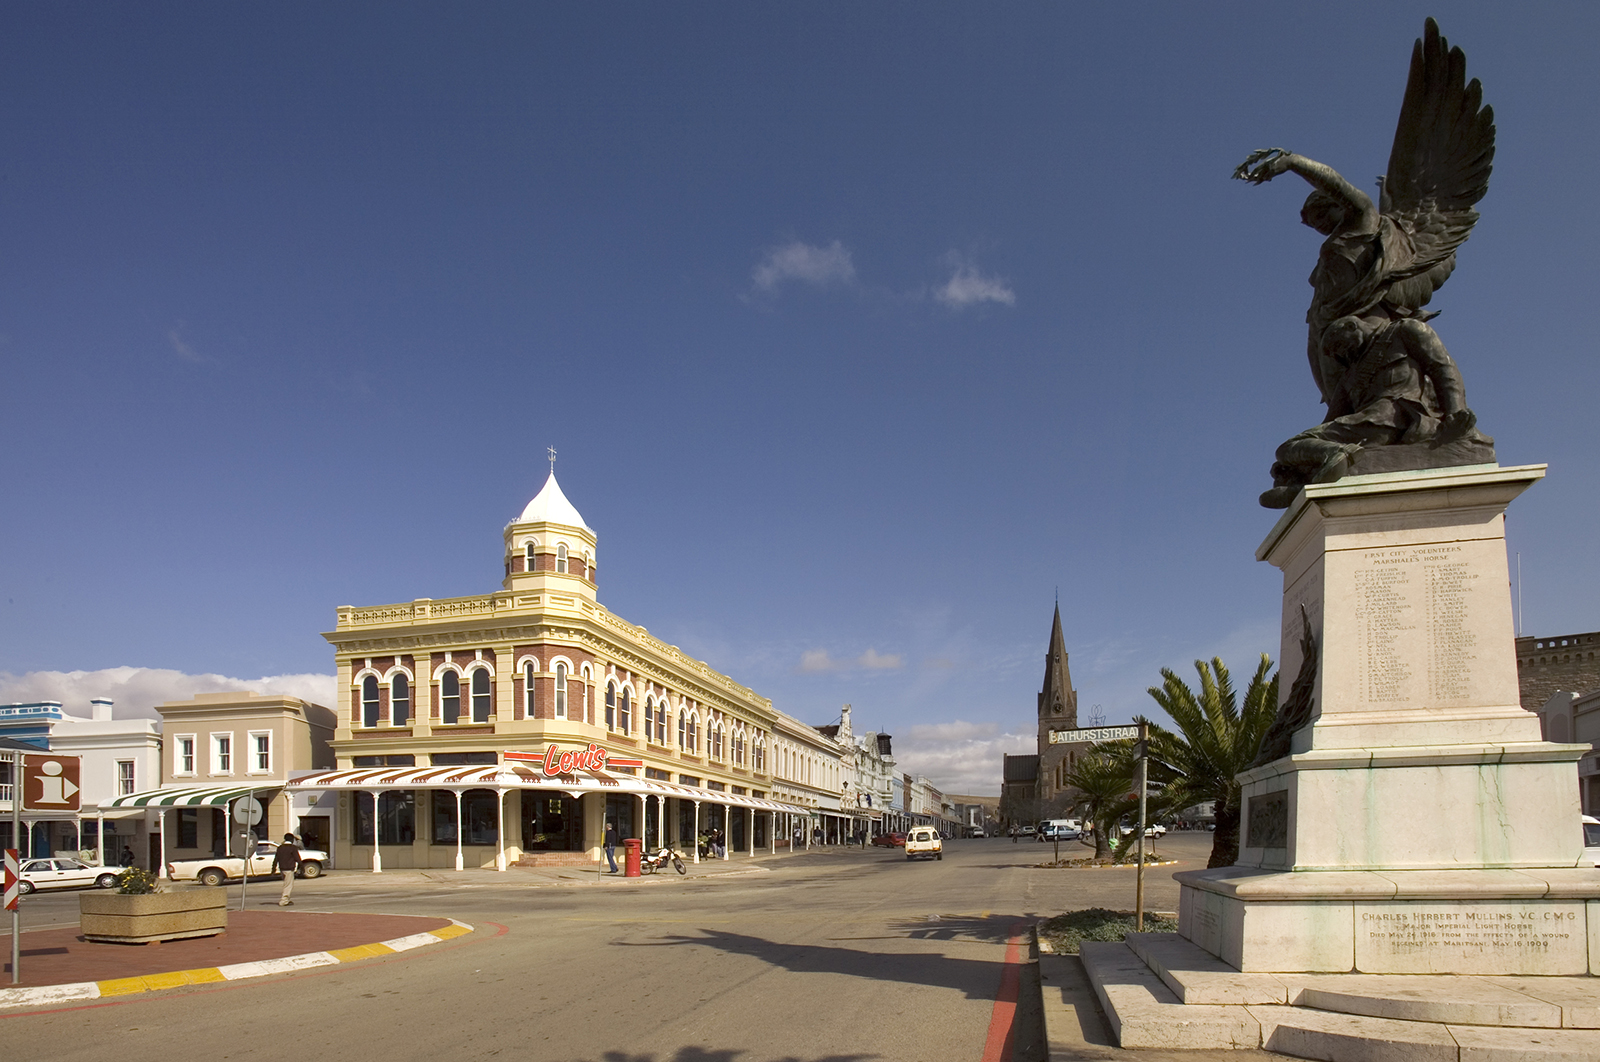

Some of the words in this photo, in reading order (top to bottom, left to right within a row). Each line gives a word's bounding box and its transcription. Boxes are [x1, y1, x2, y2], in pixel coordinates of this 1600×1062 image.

[1412, 546, 1462, 554] VOLUNTEERS
[544, 743, 607, 776] Lewis
[1362, 912, 1408, 921] CHARLES
[1413, 912, 1460, 920] HERBERT
